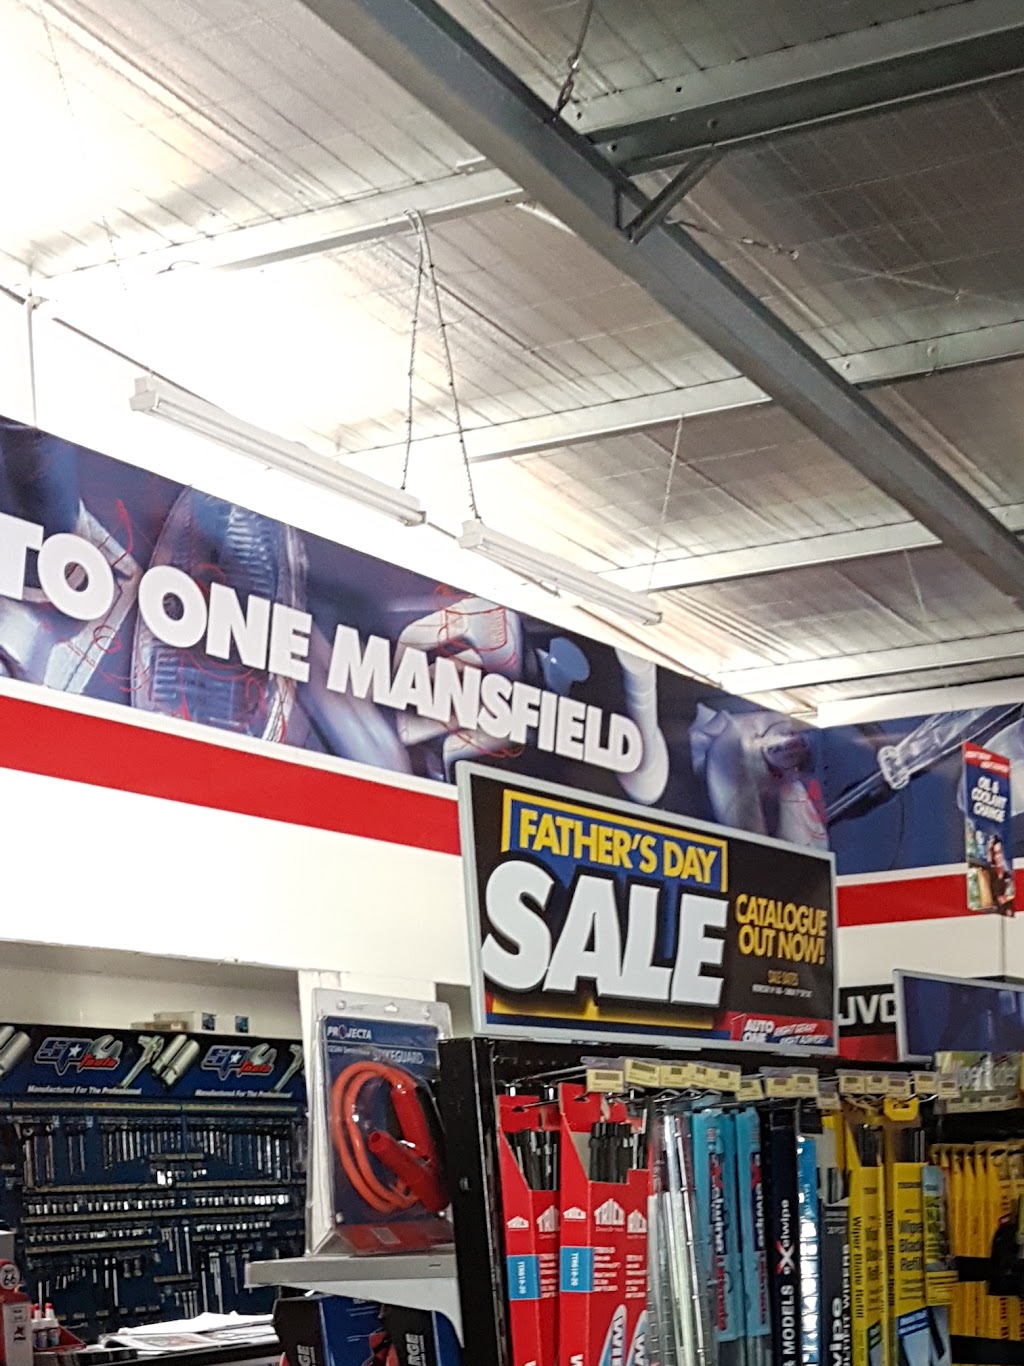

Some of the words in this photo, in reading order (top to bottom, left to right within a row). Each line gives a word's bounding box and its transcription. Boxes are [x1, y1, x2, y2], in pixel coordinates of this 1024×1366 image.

[0, 513, 114, 621] TO
[138, 565, 313, 683] ONE
[326, 623, 643, 773] MANSFIELD
[520, 809, 658, 874] FATHER'S
[663, 840, 718, 884] DAY
[481, 860, 729, 1007] SALE
[735, 894, 827, 937] CATALOGUE
[738, 925, 777, 957] OUT
[777, 931, 826, 966] NOW!
[743, 1018, 775, 1034] AUTO
[838, 993, 896, 1025] JVC
[327, 1024, 372, 1040] PROJECTA
[781, 1285, 797, 1357] MODELS
